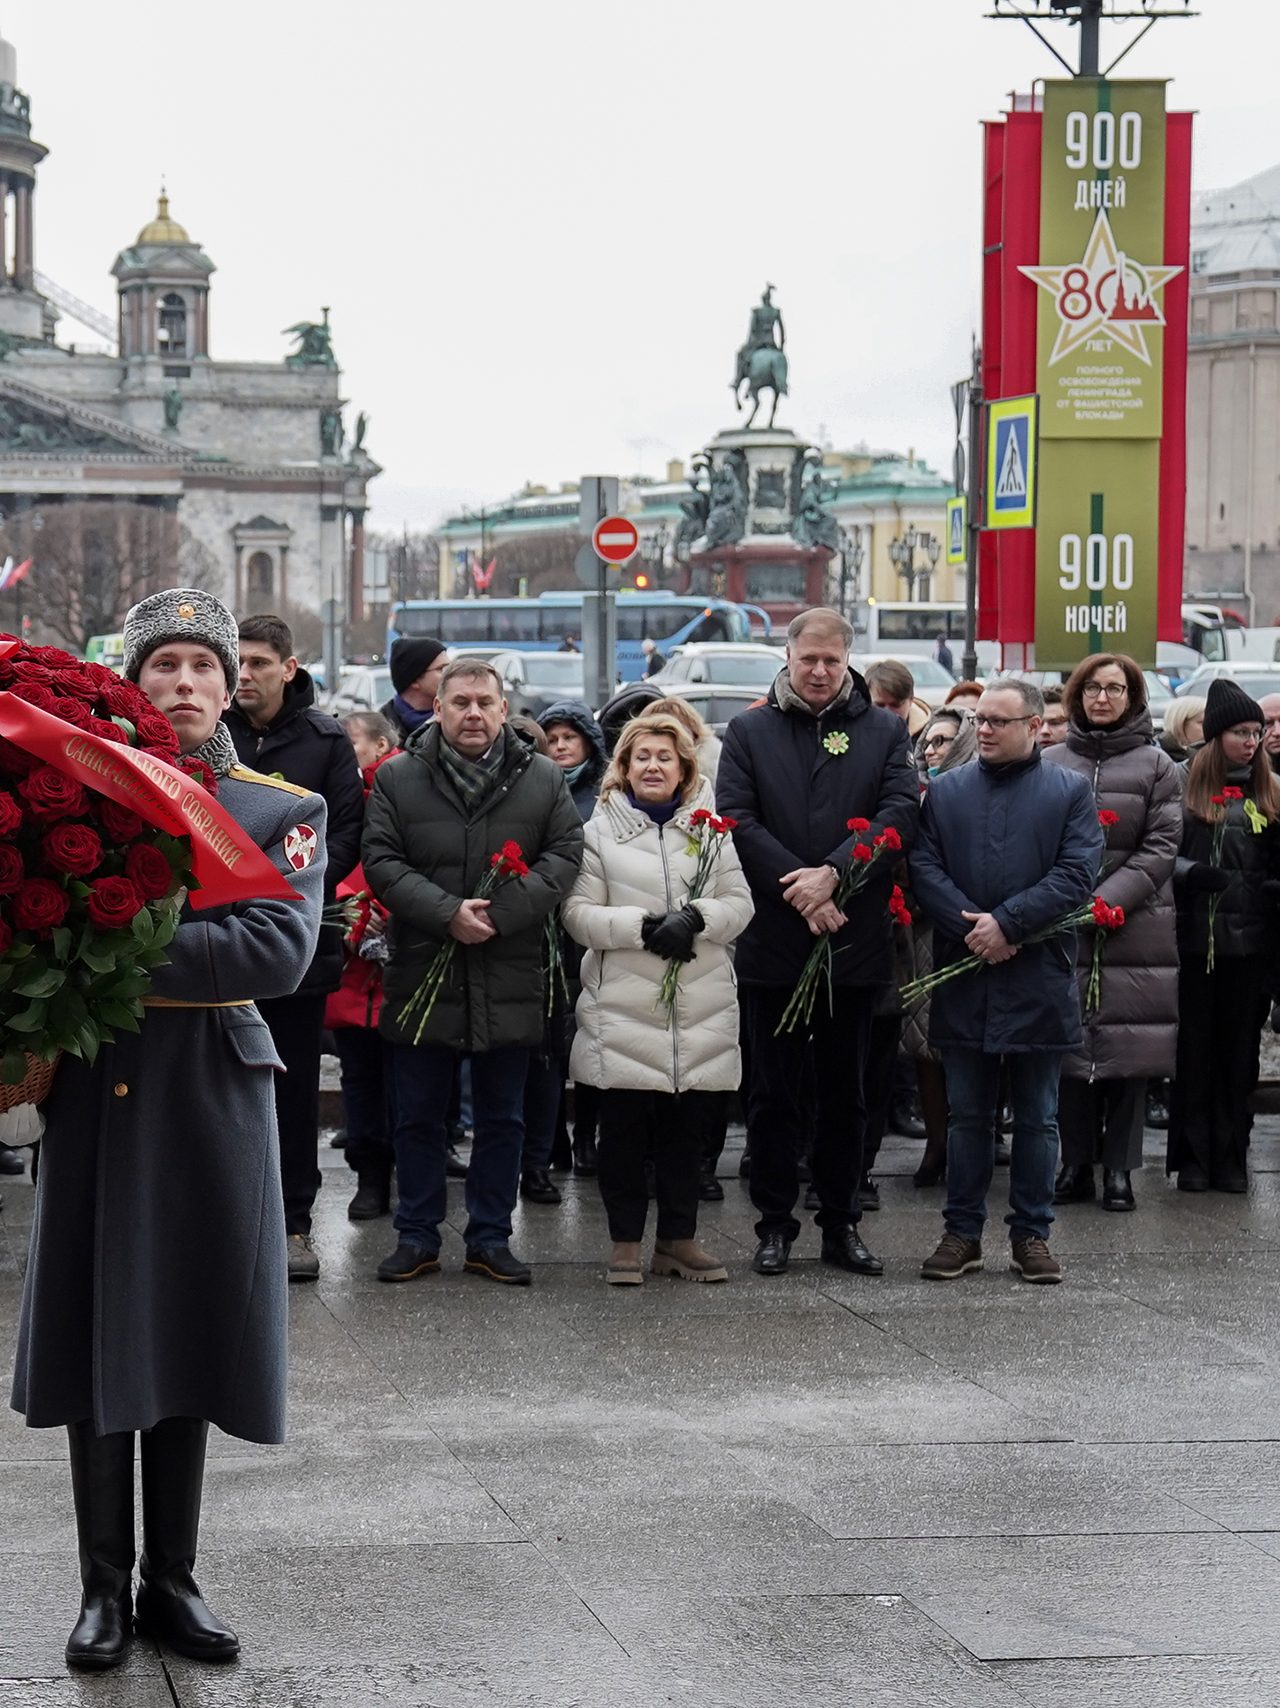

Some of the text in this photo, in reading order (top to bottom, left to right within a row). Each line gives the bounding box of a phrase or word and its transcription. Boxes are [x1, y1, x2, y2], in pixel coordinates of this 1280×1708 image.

[1066, 111, 1142, 170] 900
[1074, 176, 1126, 211] ДНЕЙ
[1085, 339, 1114, 352] ЛЕТ
[1060, 533, 1134, 591] 900
[1065, 600, 1127, 633] НОЧЕЙ
[181, 791, 244, 871] СОБРАНИЯ
